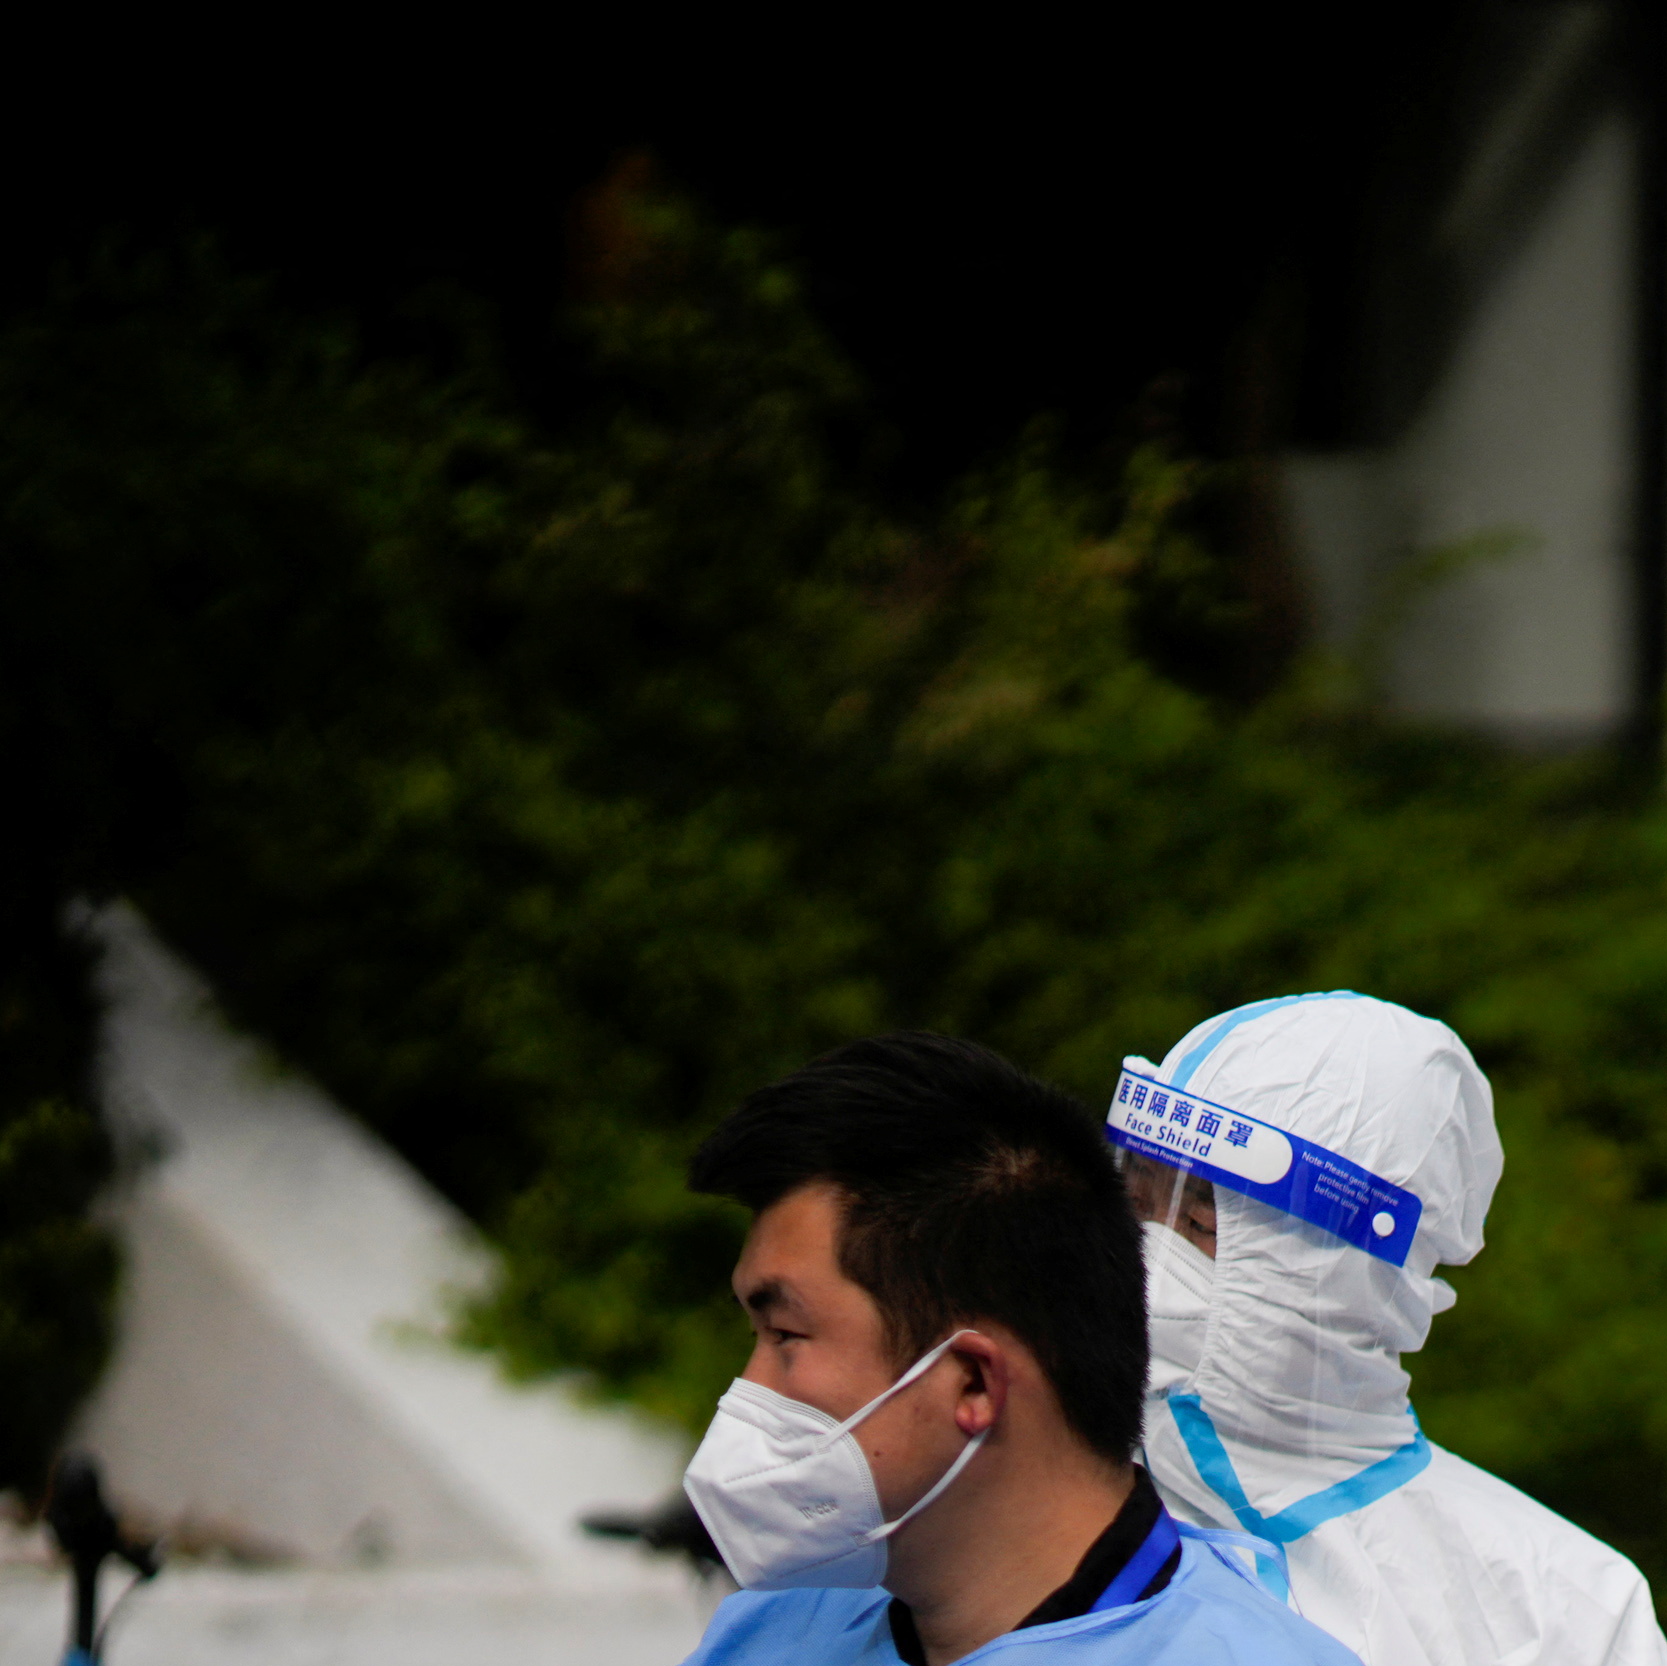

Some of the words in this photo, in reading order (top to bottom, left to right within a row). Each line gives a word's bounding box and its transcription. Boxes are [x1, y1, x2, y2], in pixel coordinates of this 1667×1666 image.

[1118, 1077, 1254, 1149] 医用隔离面罩
[1125, 1112, 1152, 1136] Face
[1156, 1125, 1212, 1157] Shield
[1313, 1183, 1340, 1202] before
[1341, 1197, 1360, 1213] using
[1317, 1173, 1356, 1196] protective
[1355, 1191, 1370, 1205] film
[1324, 1161, 1349, 1180] Please
[1349, 1175, 1370, 1193] gently
[1370, 1187, 1399, 1207] remove
